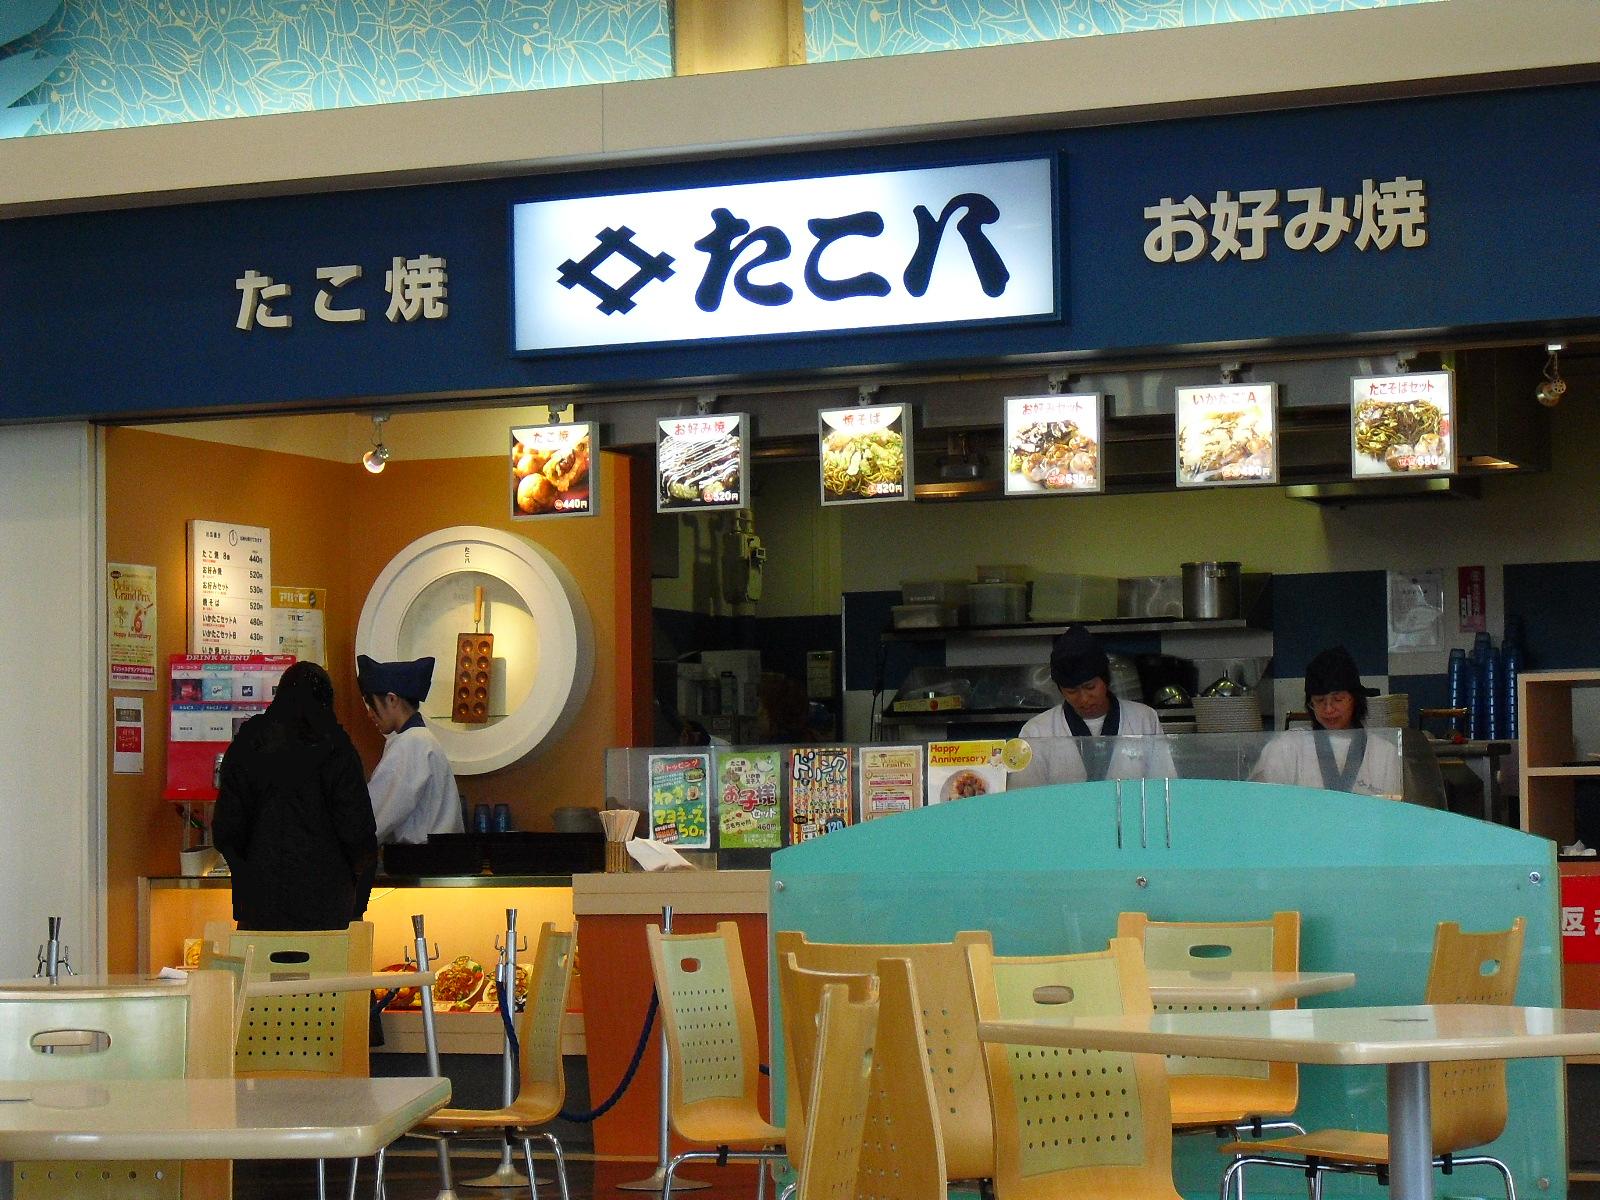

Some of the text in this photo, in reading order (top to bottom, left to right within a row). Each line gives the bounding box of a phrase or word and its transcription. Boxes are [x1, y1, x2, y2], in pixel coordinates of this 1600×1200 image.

[1143, 176, 1428, 262] お好み焼
[694, 192, 1010, 312] たこ八
[235, 254, 449, 331] たこ焼
[1369, 379, 1434, 396] たこそばセット
[843, 412, 881, 426] 焼そば
[674, 421, 725, 436] お好み焼
[533, 430, 569, 443] たこ焼
[562, 498, 588, 509] 440円
[202, 549, 219, 559] たこ焼
[249, 554, 263, 564] 440円
[202, 566, 263, 579] お好み焼 520円
[202, 581, 263, 594] お好みセット 530円
[202, 598, 263, 611] 焼そば 520円
[202, 614, 263, 627] いかたこセットA 480円
[202, 629, 263, 641] いかたこセットB 430円
[930, 744, 960, 754] Happy
[665, 759, 698, 771] トッピング
[930, 755, 987, 764] Anniversary
[654, 785, 685, 805] ねぎ
[723, 783, 776, 812] お子様
[653, 803, 705, 825] マヨネーズ
[752, 807, 777, 819] セット
[678, 824, 705, 838] 50円
[1562, 906, 1600, 936] 区
